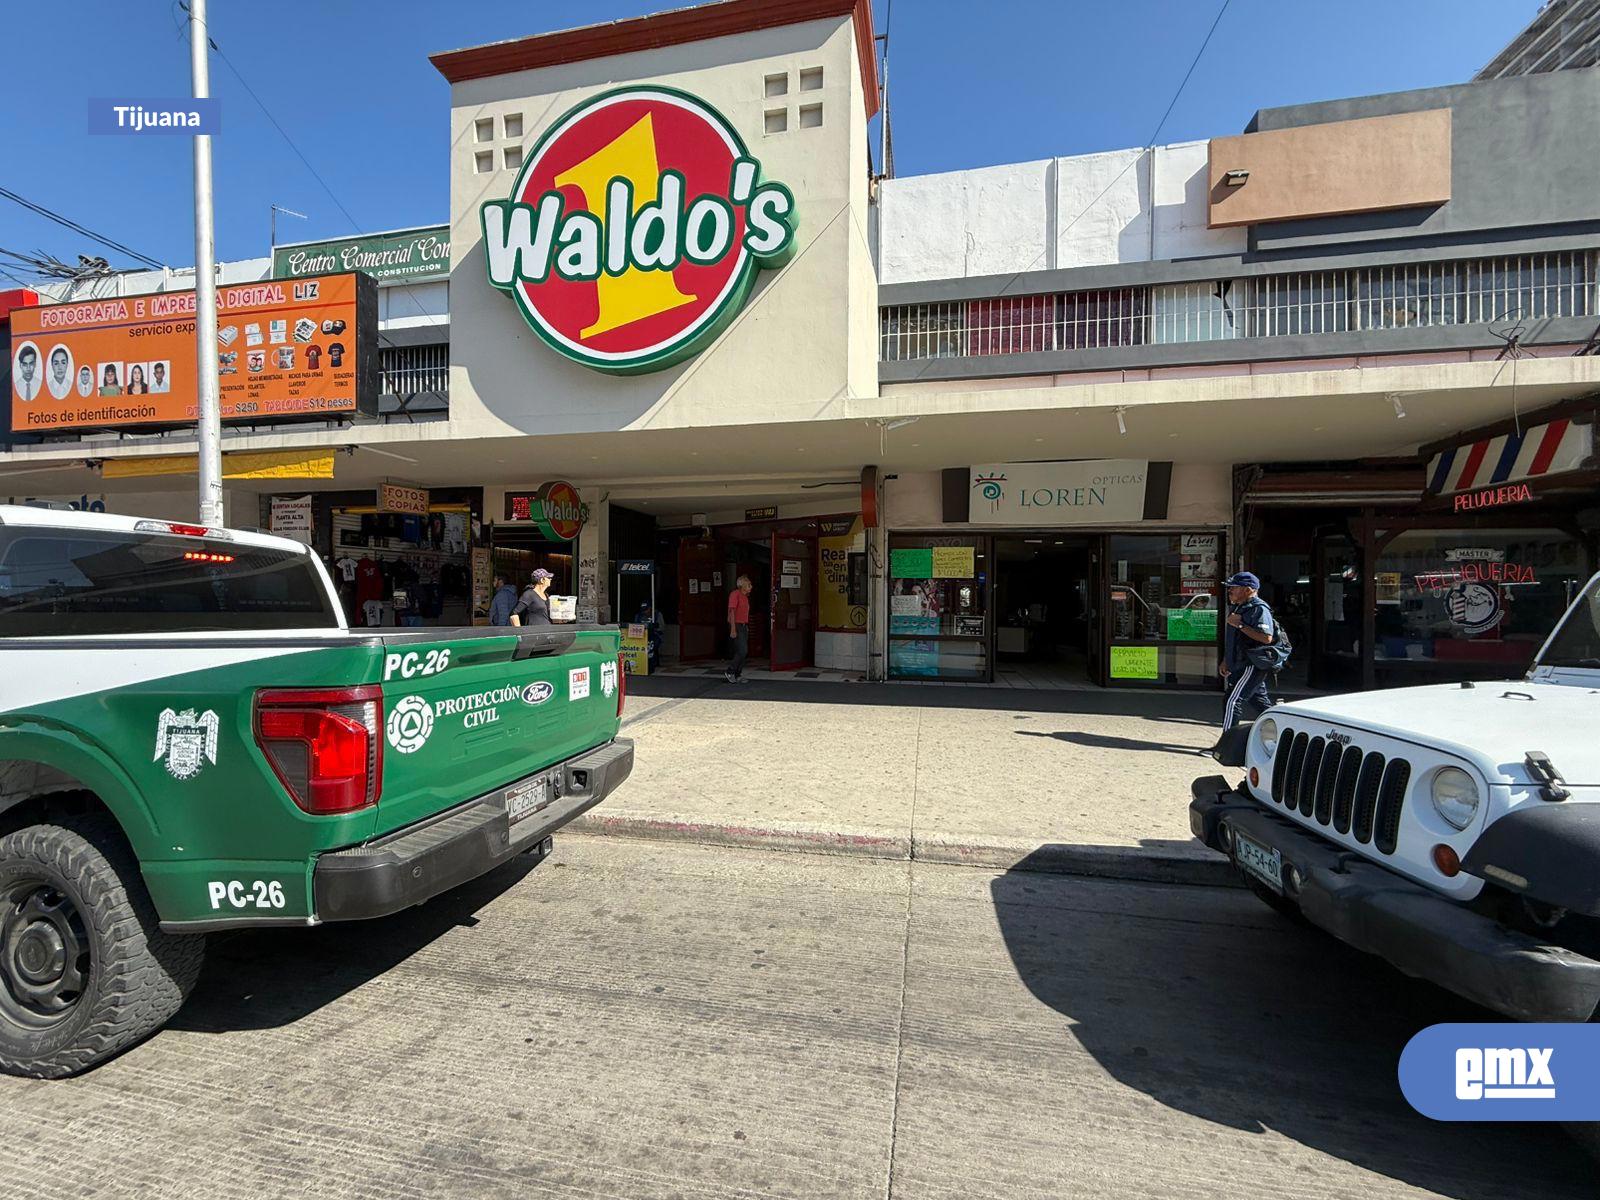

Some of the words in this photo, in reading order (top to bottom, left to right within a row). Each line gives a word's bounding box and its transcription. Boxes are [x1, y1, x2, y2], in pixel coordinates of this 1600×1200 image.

[483, 161, 789, 284] Waldo's
[288, 251, 336, 276] Centro
[341, 239, 418, 270] Comercial
[418, 236, 451, 261] Con
[378, 263, 441, 277] CONSTITUCION
[41, 302, 128, 326] FOTOGRAFIA
[135, 301, 145, 318] E
[152, 294, 223, 317] IMPREA
[228, 285, 285, 307] DIGITAL
[294, 282, 319, 299] LIZ
[129, 322, 173, 337] servicio
[27, 411, 57, 424] Fotos
[60, 409, 74, 422] de
[77, 403, 156, 421] identificación
[236, 402, 258, 413] $250
[327, 399, 353, 410] pesos
[1092, 474, 1144, 486] OPTICAS
[388, 487, 425, 502] FOTOS
[388, 499, 425, 512] COPIAS
[1020, 486, 1107, 508] LOREN
[1454, 483, 1533, 512] PELUQUERIA
[541, 498, 588, 521] Waldo's
[1414, 561, 1537, 594] PELUQUERIA
[384, 648, 451, 681] PC-26
[435, 683, 521, 718] PROTECCIÓN
[463, 707, 500, 729] CIVIL
[1326, 729, 1352, 746] Jeep
[207, 879, 286, 910] PC-26
